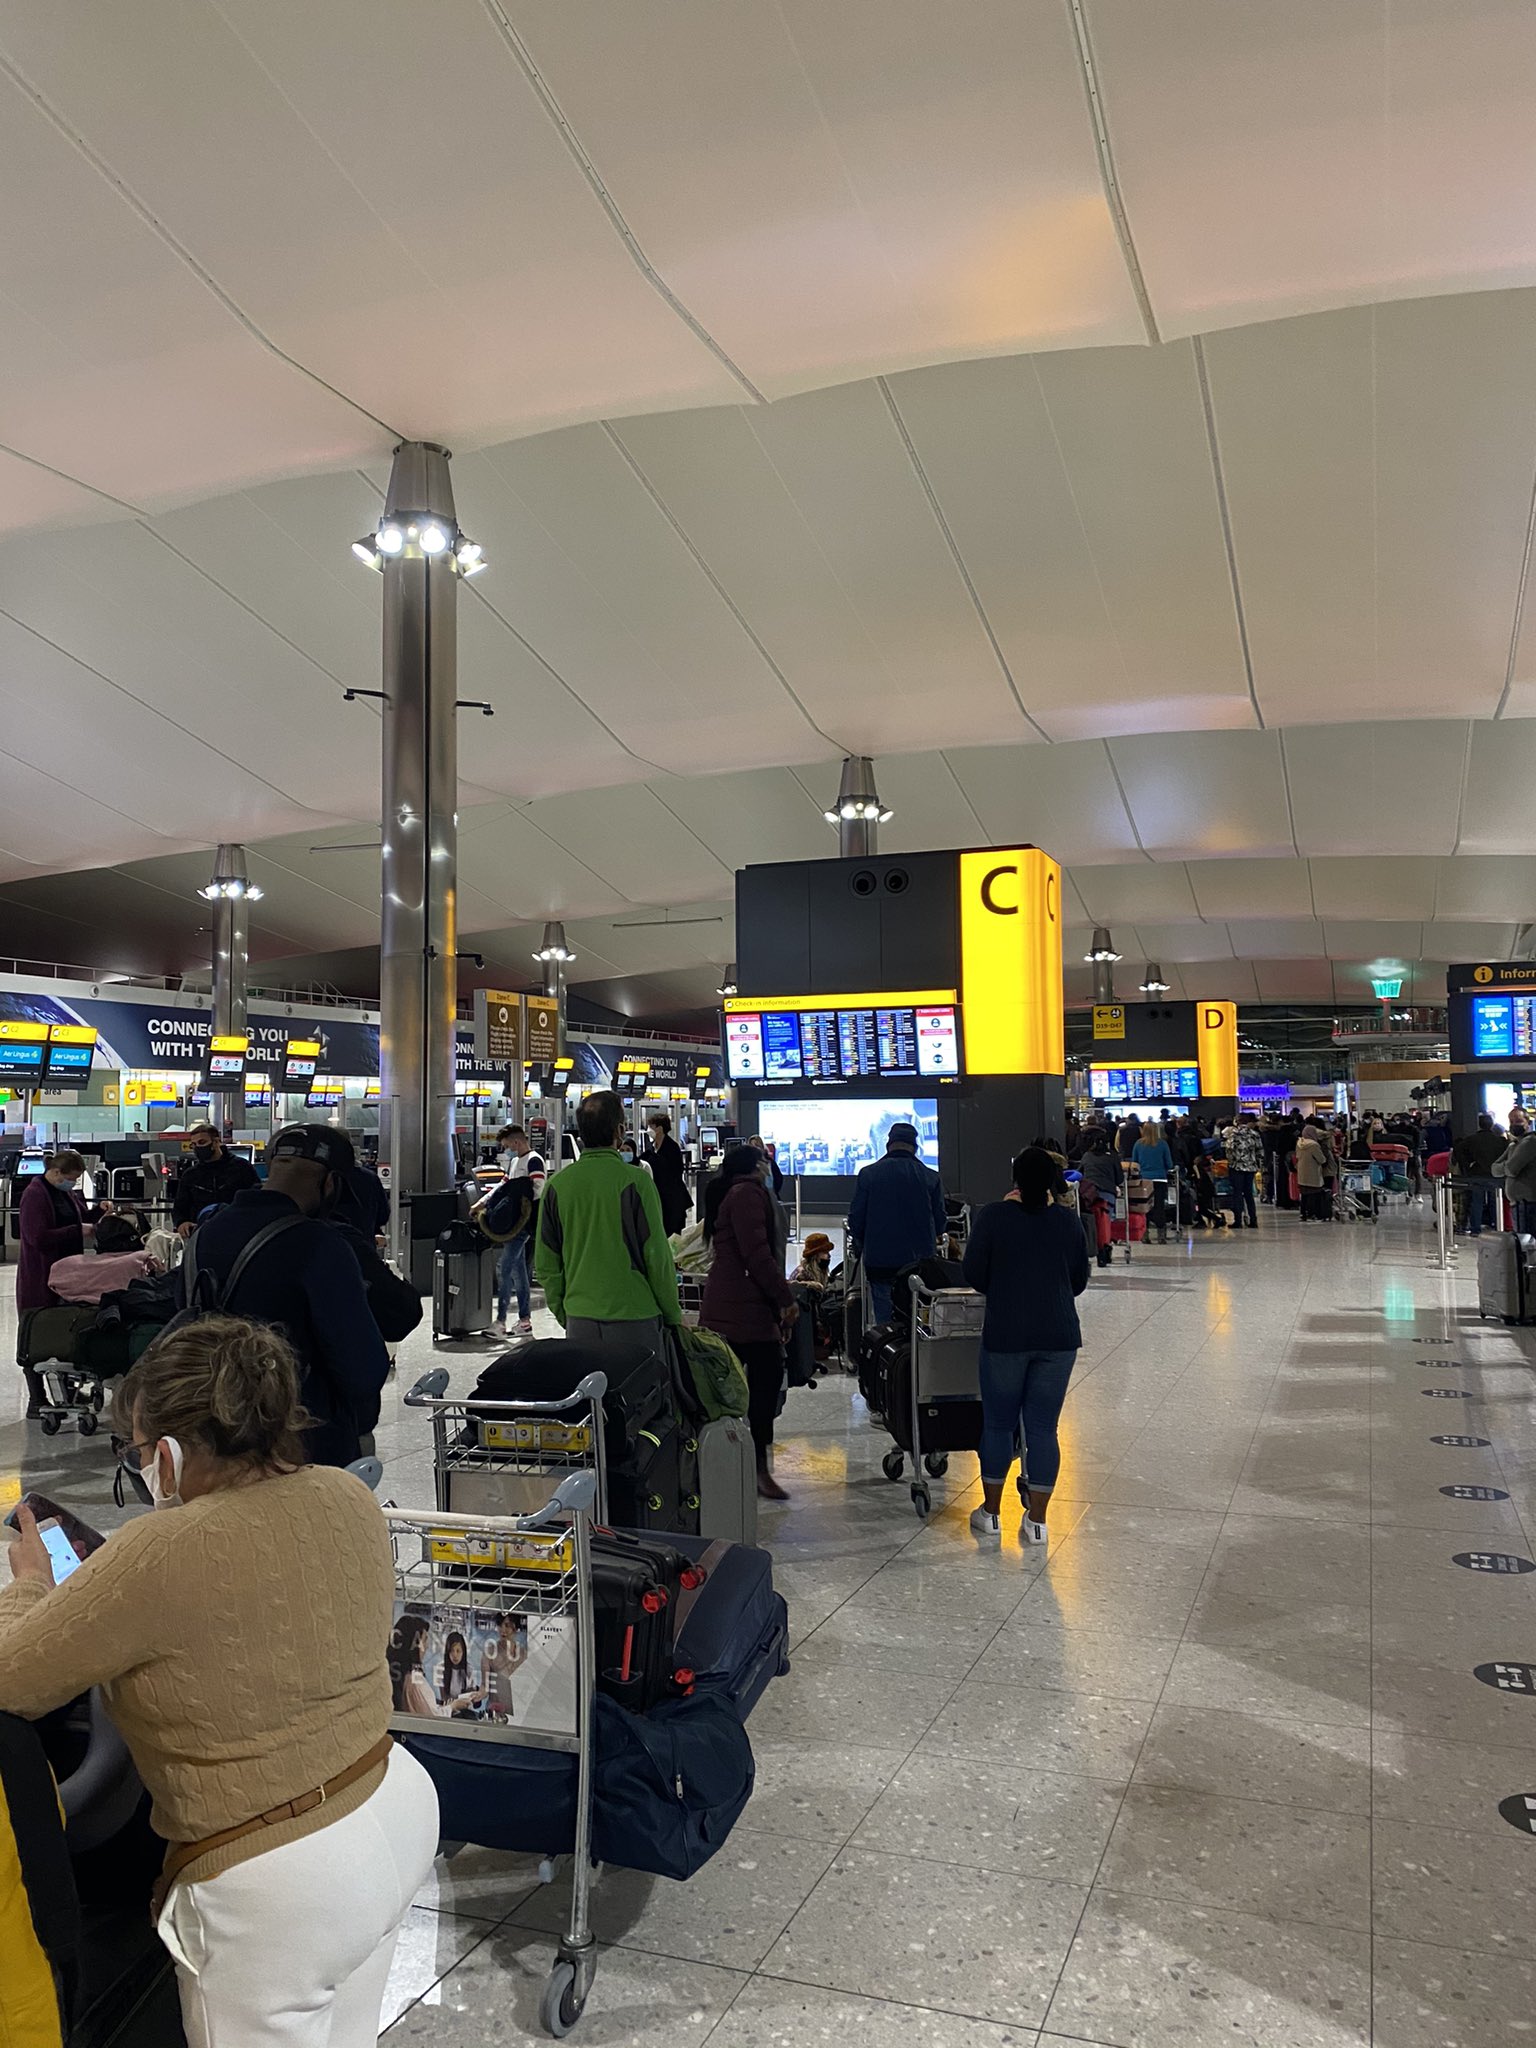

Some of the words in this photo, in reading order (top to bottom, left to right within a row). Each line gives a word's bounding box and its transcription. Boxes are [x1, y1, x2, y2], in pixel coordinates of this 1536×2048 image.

[980, 865, 1019, 915] C
[1046, 873, 1054, 922] C
[1205, 1009, 1224, 1029] D
[258, 1028, 289, 1042] YOU
[150, 1041, 193, 1058] WITH
[456, 1058, 472, 1070] ITH
[474, 1059, 493, 1070] THE
[665, 1058, 678, 1067] YOU
[655, 1070, 677, 1079] WORLD
